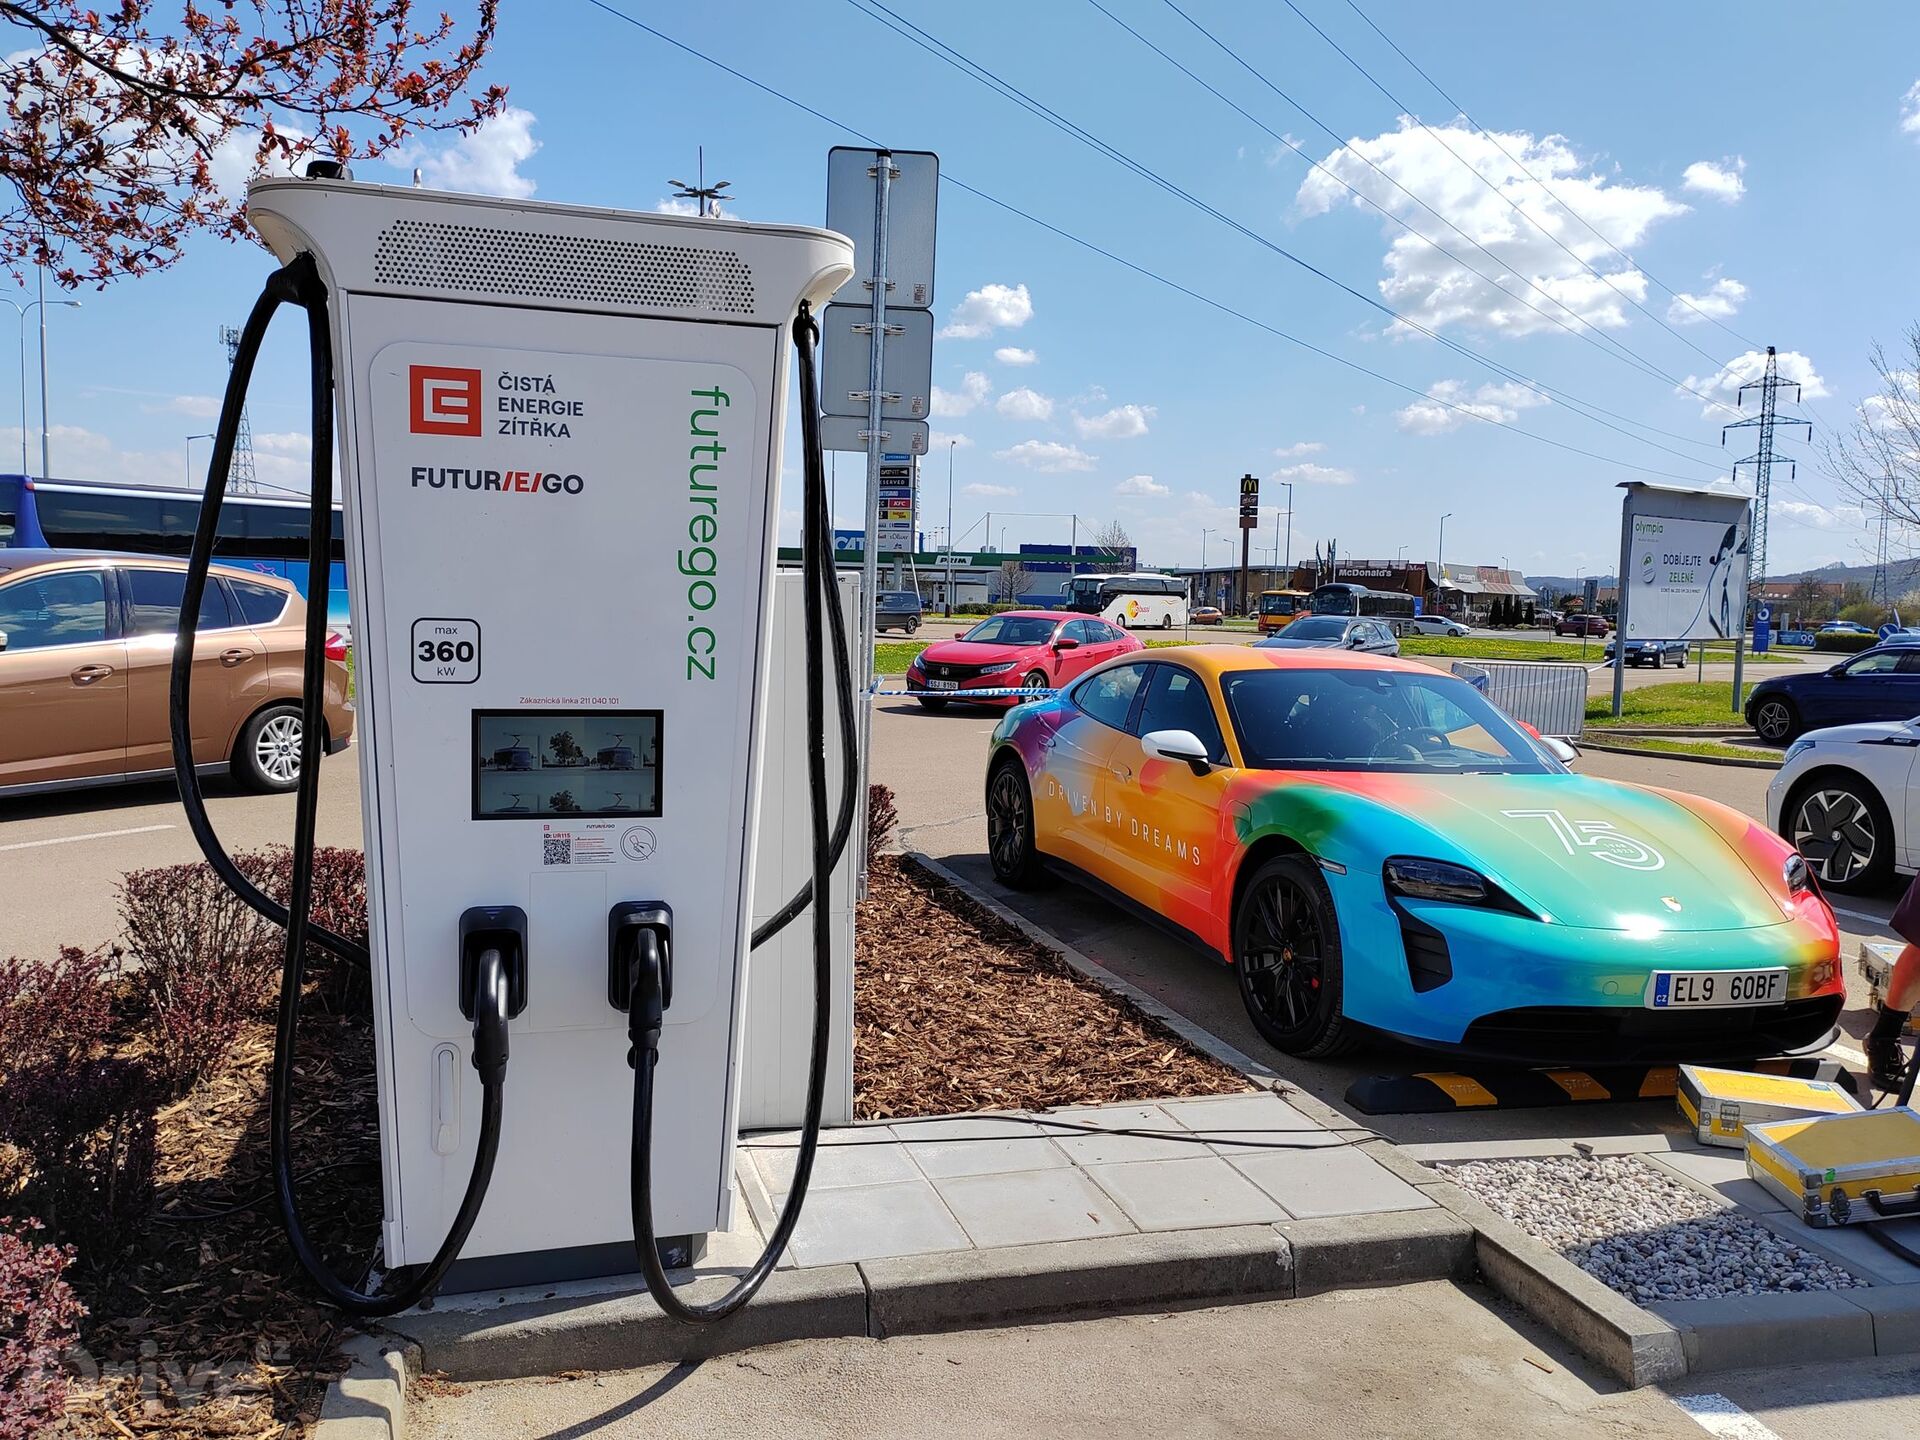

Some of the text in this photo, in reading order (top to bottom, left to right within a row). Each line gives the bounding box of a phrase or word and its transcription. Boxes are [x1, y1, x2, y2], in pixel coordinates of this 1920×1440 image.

[498, 371, 556, 393] ČISTÁ
[498, 397, 584, 417] ENERGIE
[498, 417, 571, 438] ZÍTŘKA
[411, 466, 585, 495] FUTUR/E/GO
[678, 386, 730, 681] futurego.cz
[1635, 520, 1664, 535] olympia
[1663, 552, 1702, 567] DOBÍJEJTE
[1338, 569, 1392, 578] McDonald's
[434, 626, 458, 635] max
[417, 640, 475, 663] 360
[437, 666, 457, 677] kW
[519, 696, 560, 705] Zákaznická
[562, 697, 579, 705] linka
[580, 697, 591, 705] 211
[592, 697, 607, 705] 040
[1048, 781, 1200, 866] DRIVEN BY DREAMS
[1499, 809, 1666, 871] 75
[1673, 974, 1780, 1002] EL9 60BF
[1656, 994, 1667, 1003] CZ
